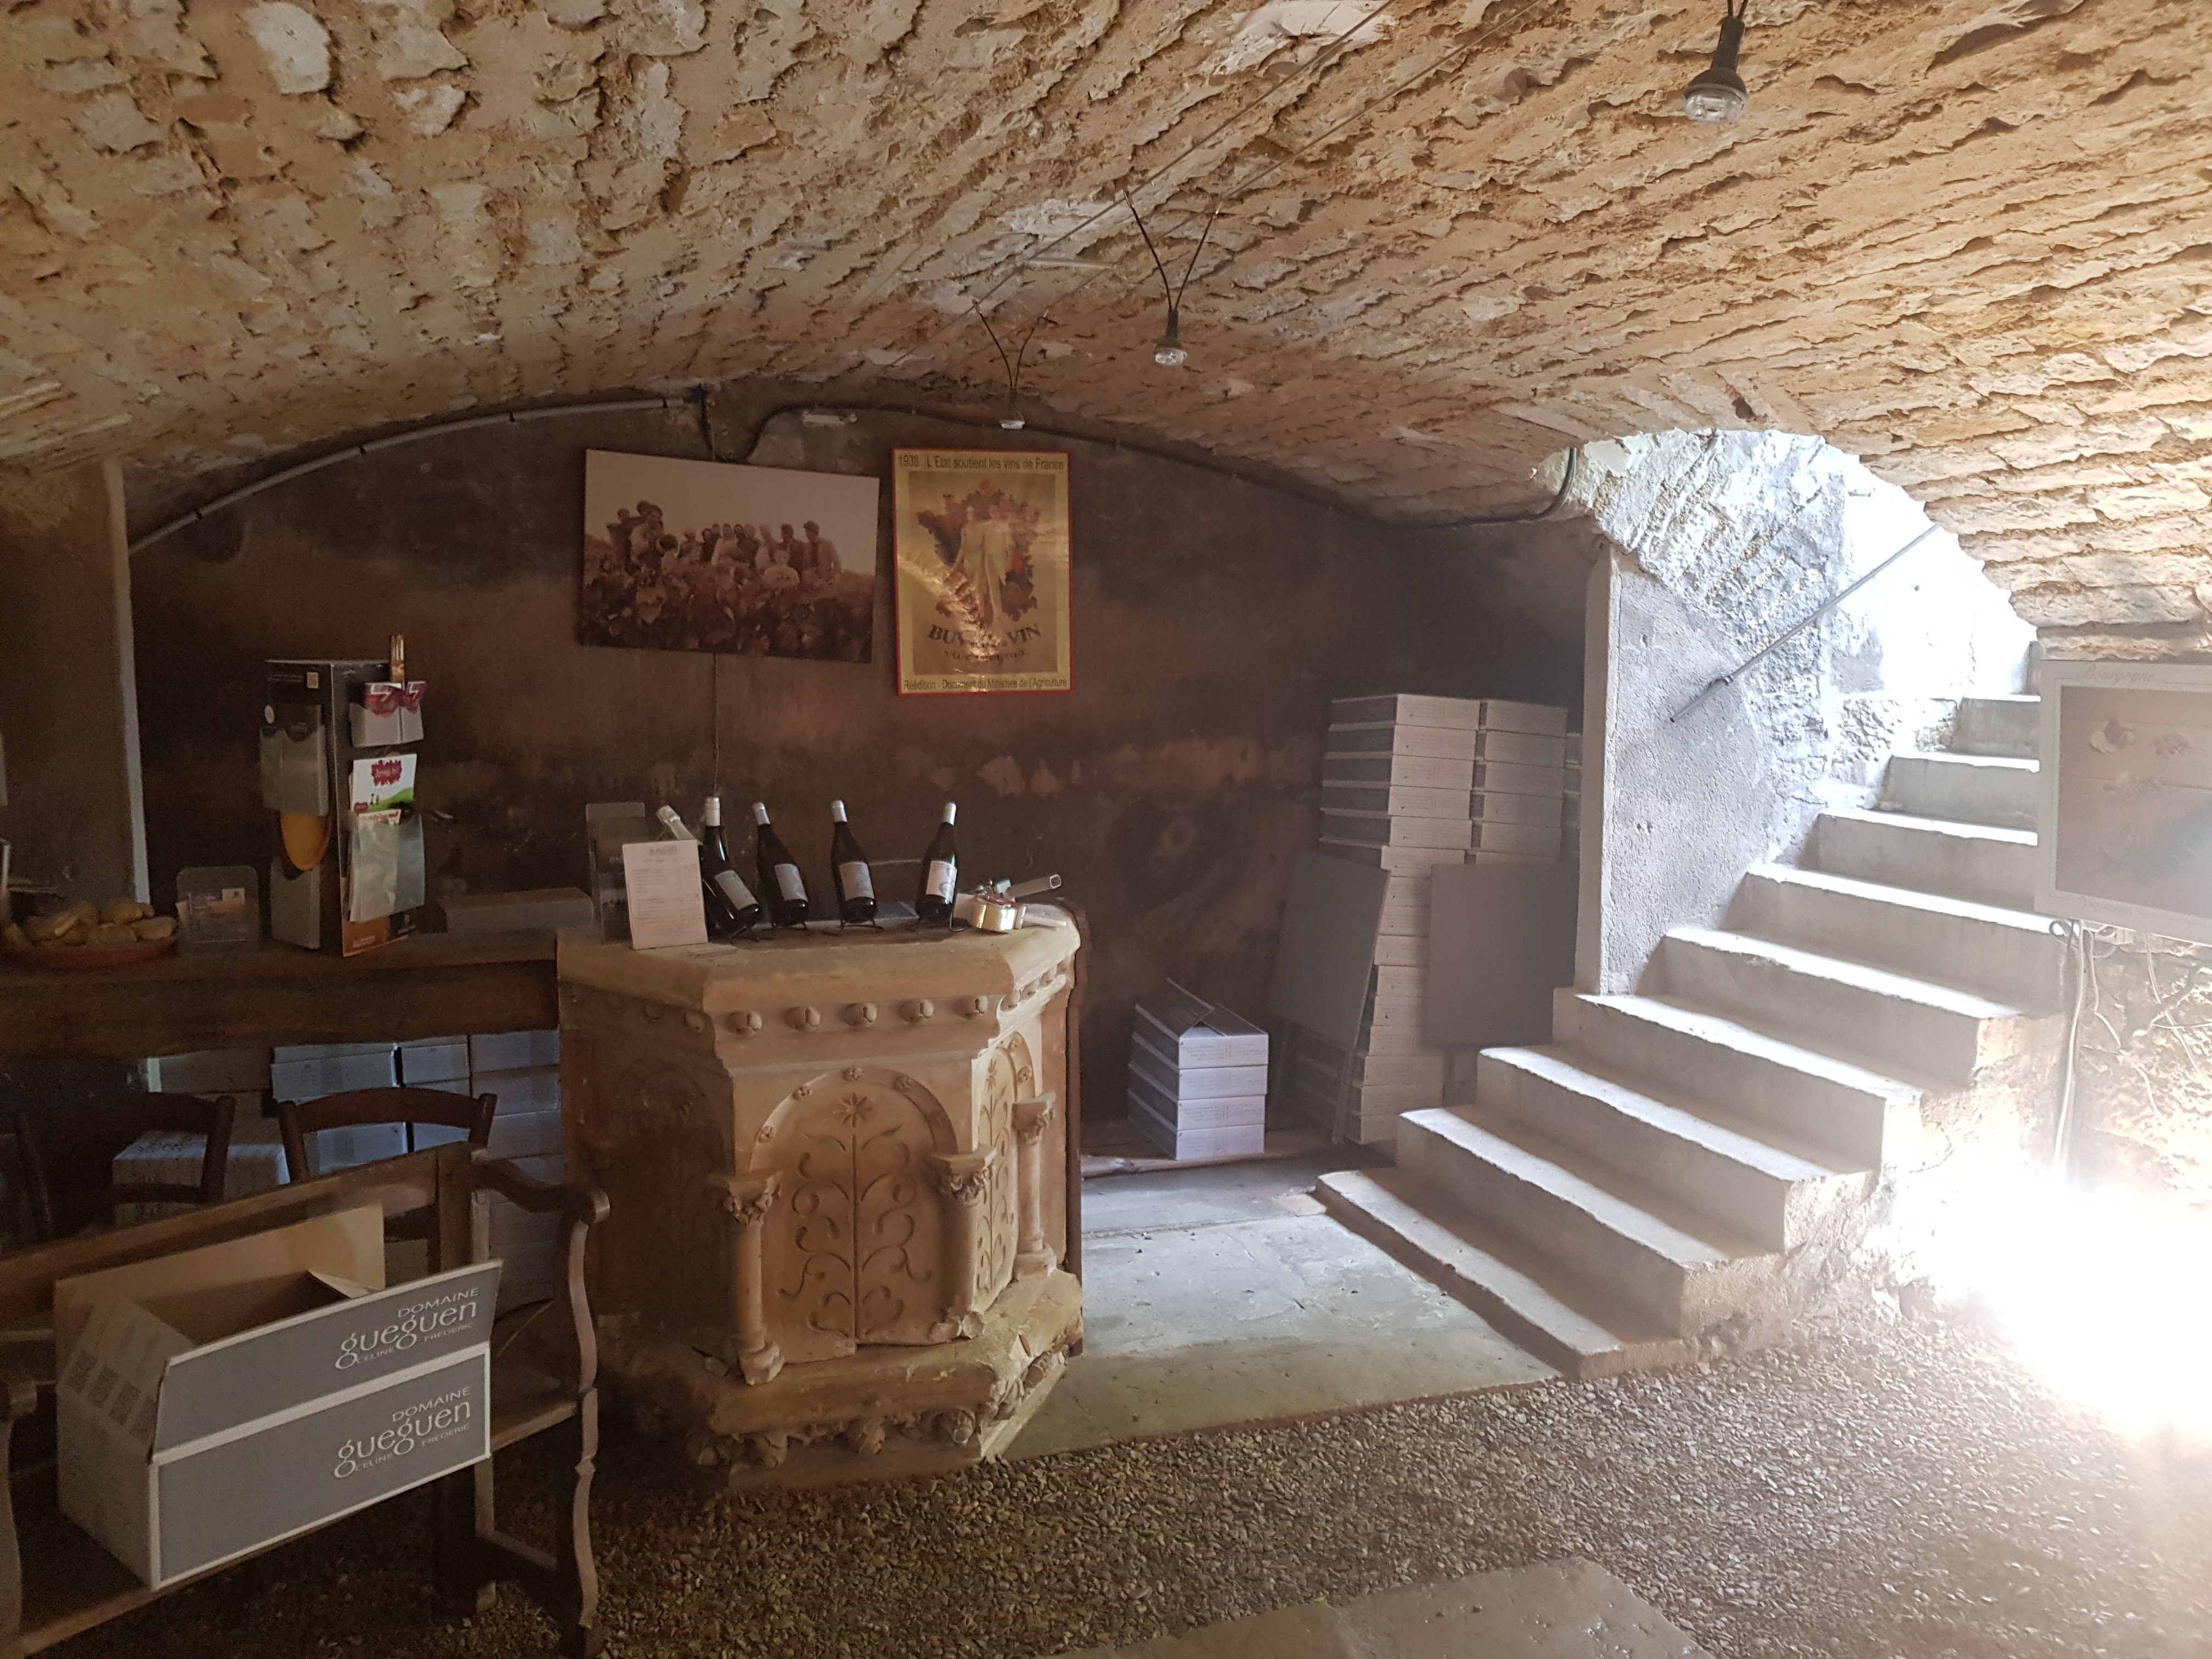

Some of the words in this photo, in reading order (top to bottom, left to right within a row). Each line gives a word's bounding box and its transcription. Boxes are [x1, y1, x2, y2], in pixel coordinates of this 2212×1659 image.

[898, 454, 919, 467] 1938
[953, 456, 986, 469] soutient
[989, 456, 1001, 469] les
[1003, 458, 1020, 470] vins
[1023, 458, 1032, 470] de
[1035, 458, 1064, 471] France
[1007, 622, 1042, 645] VIN
[398, 1287, 479, 1318] DOMAINE
[334, 1301, 477, 1369] gueguen
[392, 1386, 471, 1422] DOMAINE
[334, 1401, 471, 1478] gueguen
